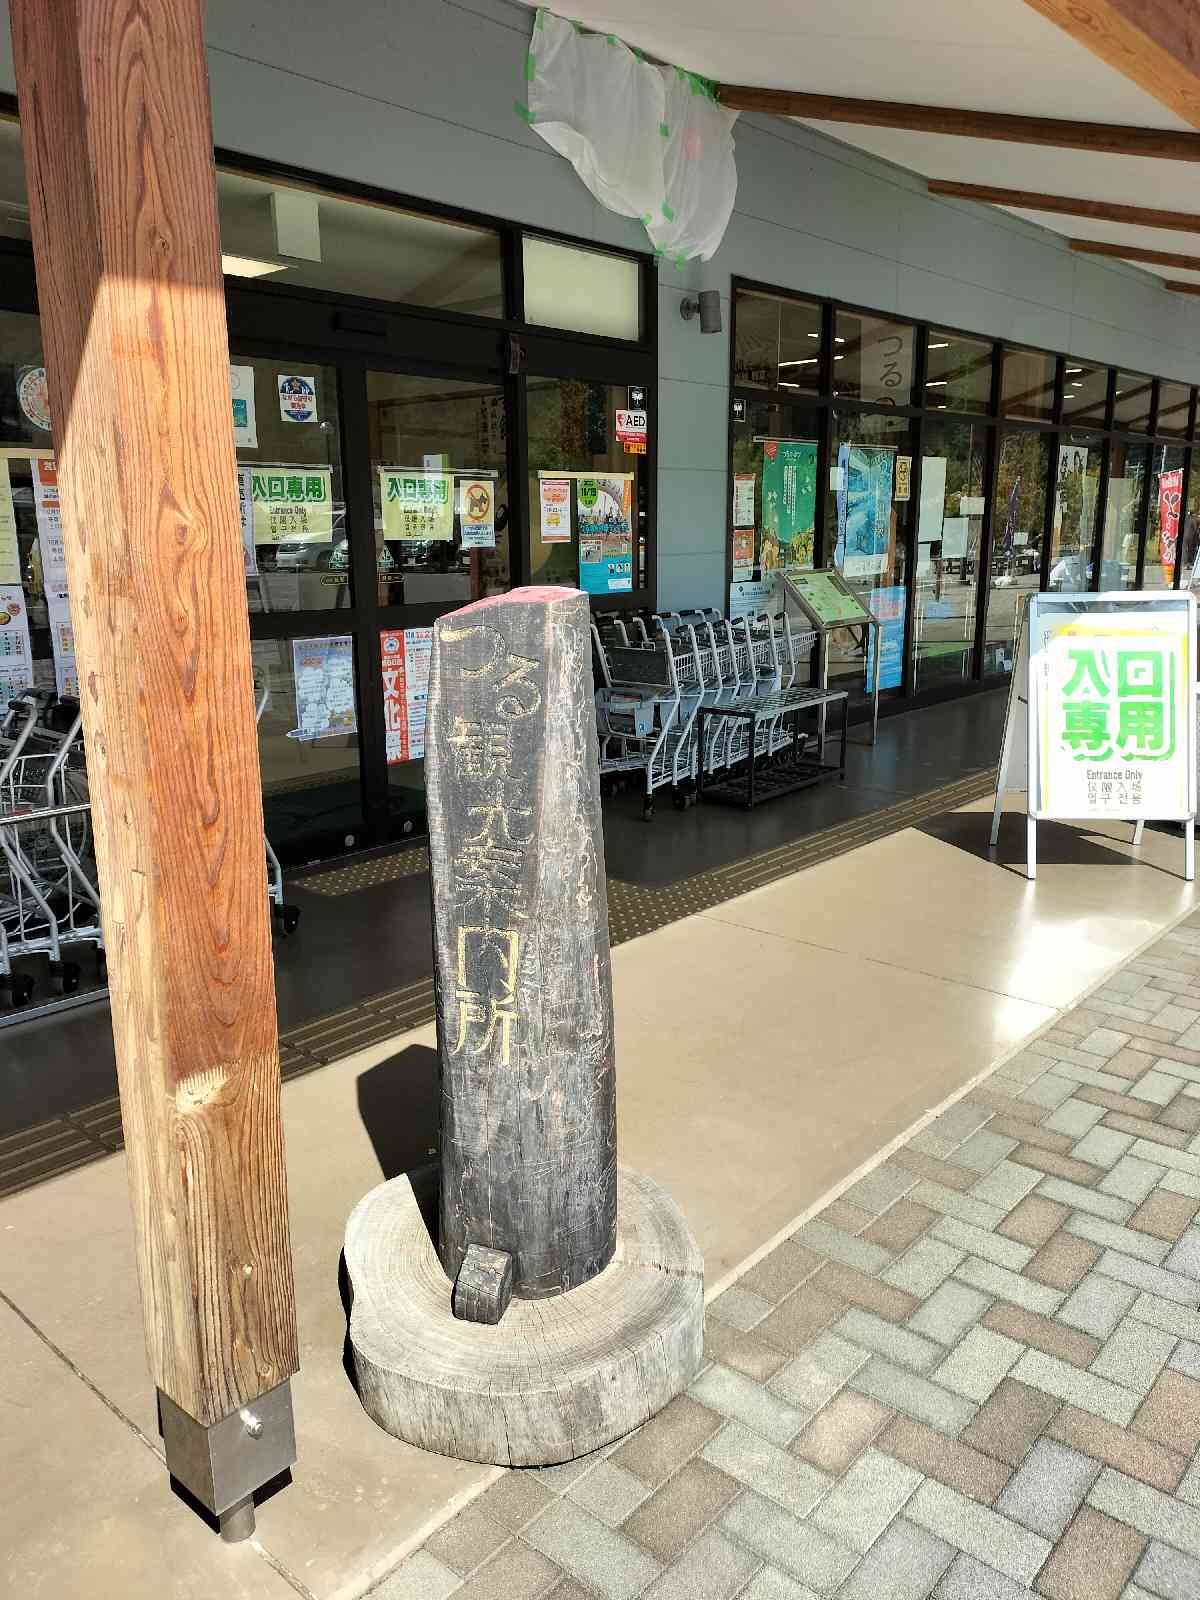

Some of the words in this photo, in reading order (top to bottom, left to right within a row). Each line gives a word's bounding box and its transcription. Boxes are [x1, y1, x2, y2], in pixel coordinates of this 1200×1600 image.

[625, 415, 646, 427] AED
[252, 475, 325, 501] 入口専用
[1061, 649, 1166, 698] 入口
[1061, 700, 1166, 752] 専用
[1086, 769, 1123, 780] Entrance
[1125, 769, 1143, 783] Only
